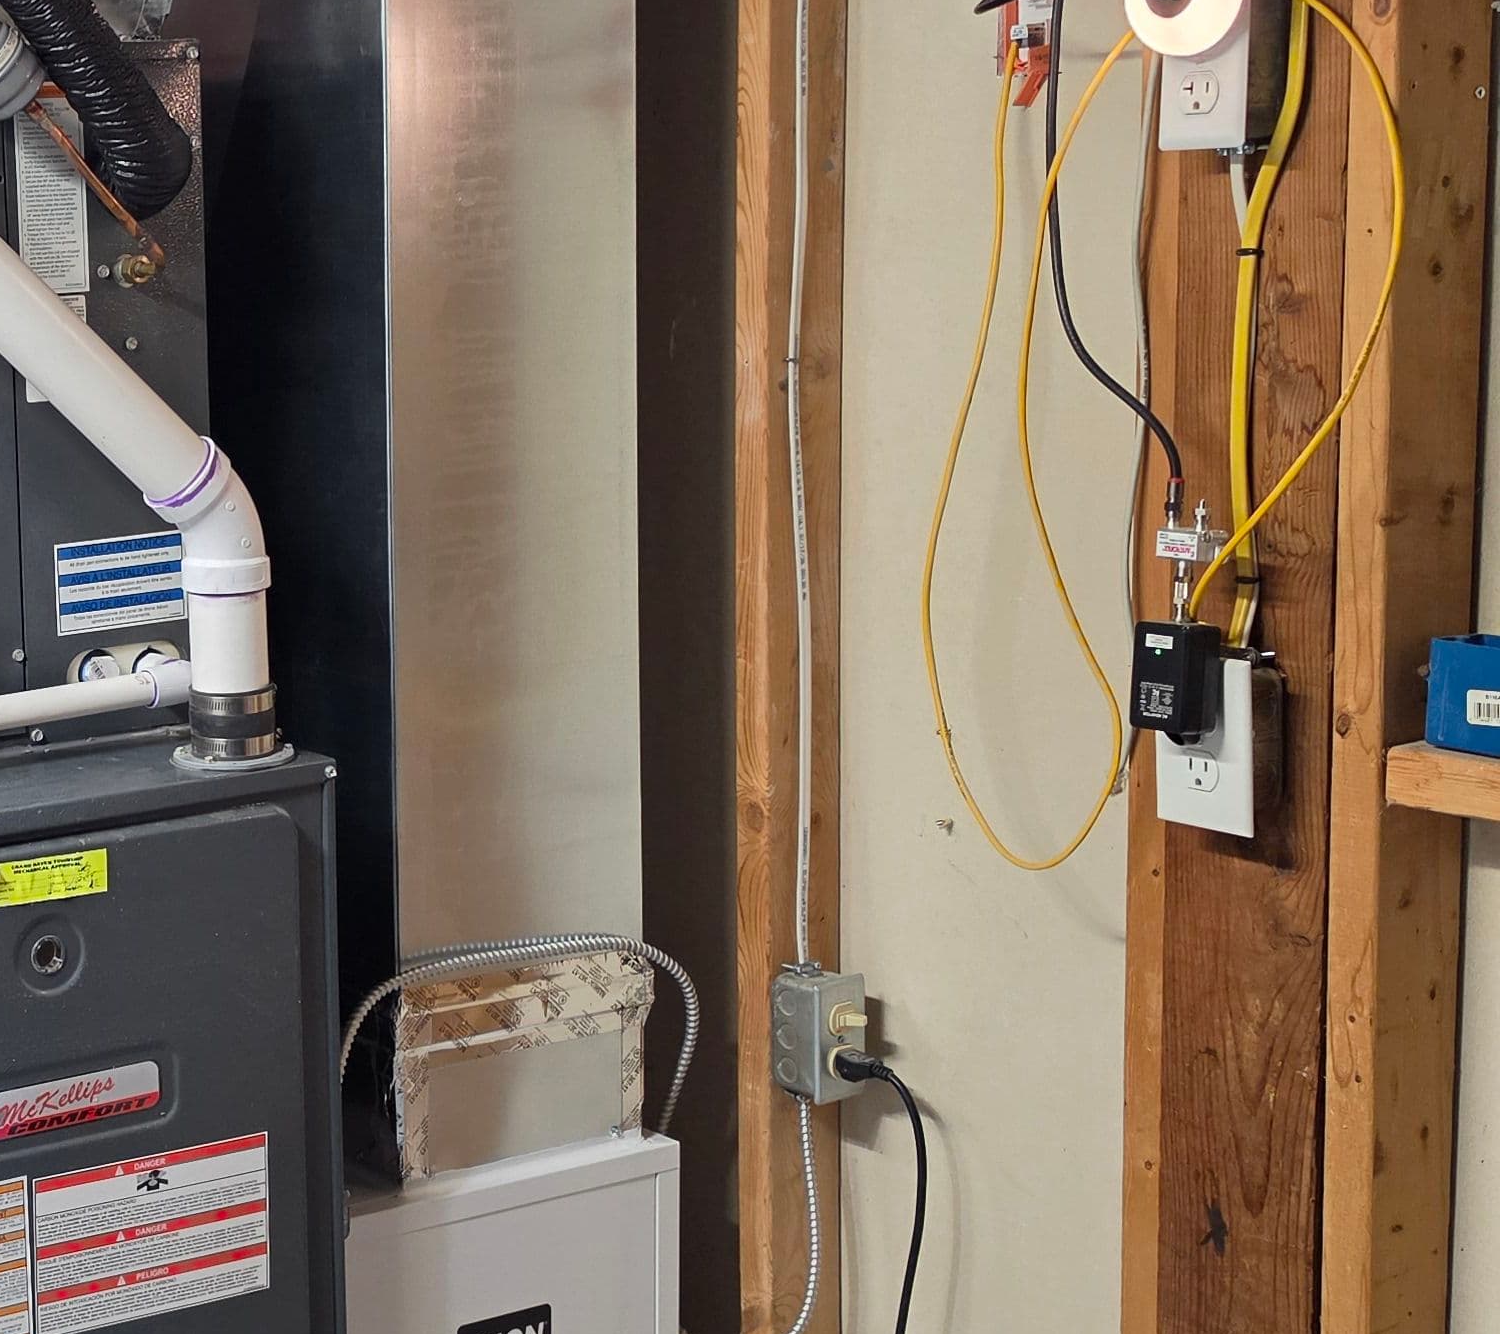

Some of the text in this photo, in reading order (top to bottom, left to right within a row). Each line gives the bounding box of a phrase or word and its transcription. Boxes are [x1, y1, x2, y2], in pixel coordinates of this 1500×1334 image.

[71, 536, 168, 557] INSTALLATION NOTICE
[70, 574, 91, 585] AVIS
[71, 602, 98, 614] AVISO
[100, 601, 114, 611] DE
[0, 1076, 115, 1125] McKellips
[7, 1096, 151, 1136] COMFORT
[133, 1157, 166, 1171] DANGER
[135, 1223, 168, 1237] DANGER
[136, 1267, 170, 1281] PELIGRO
